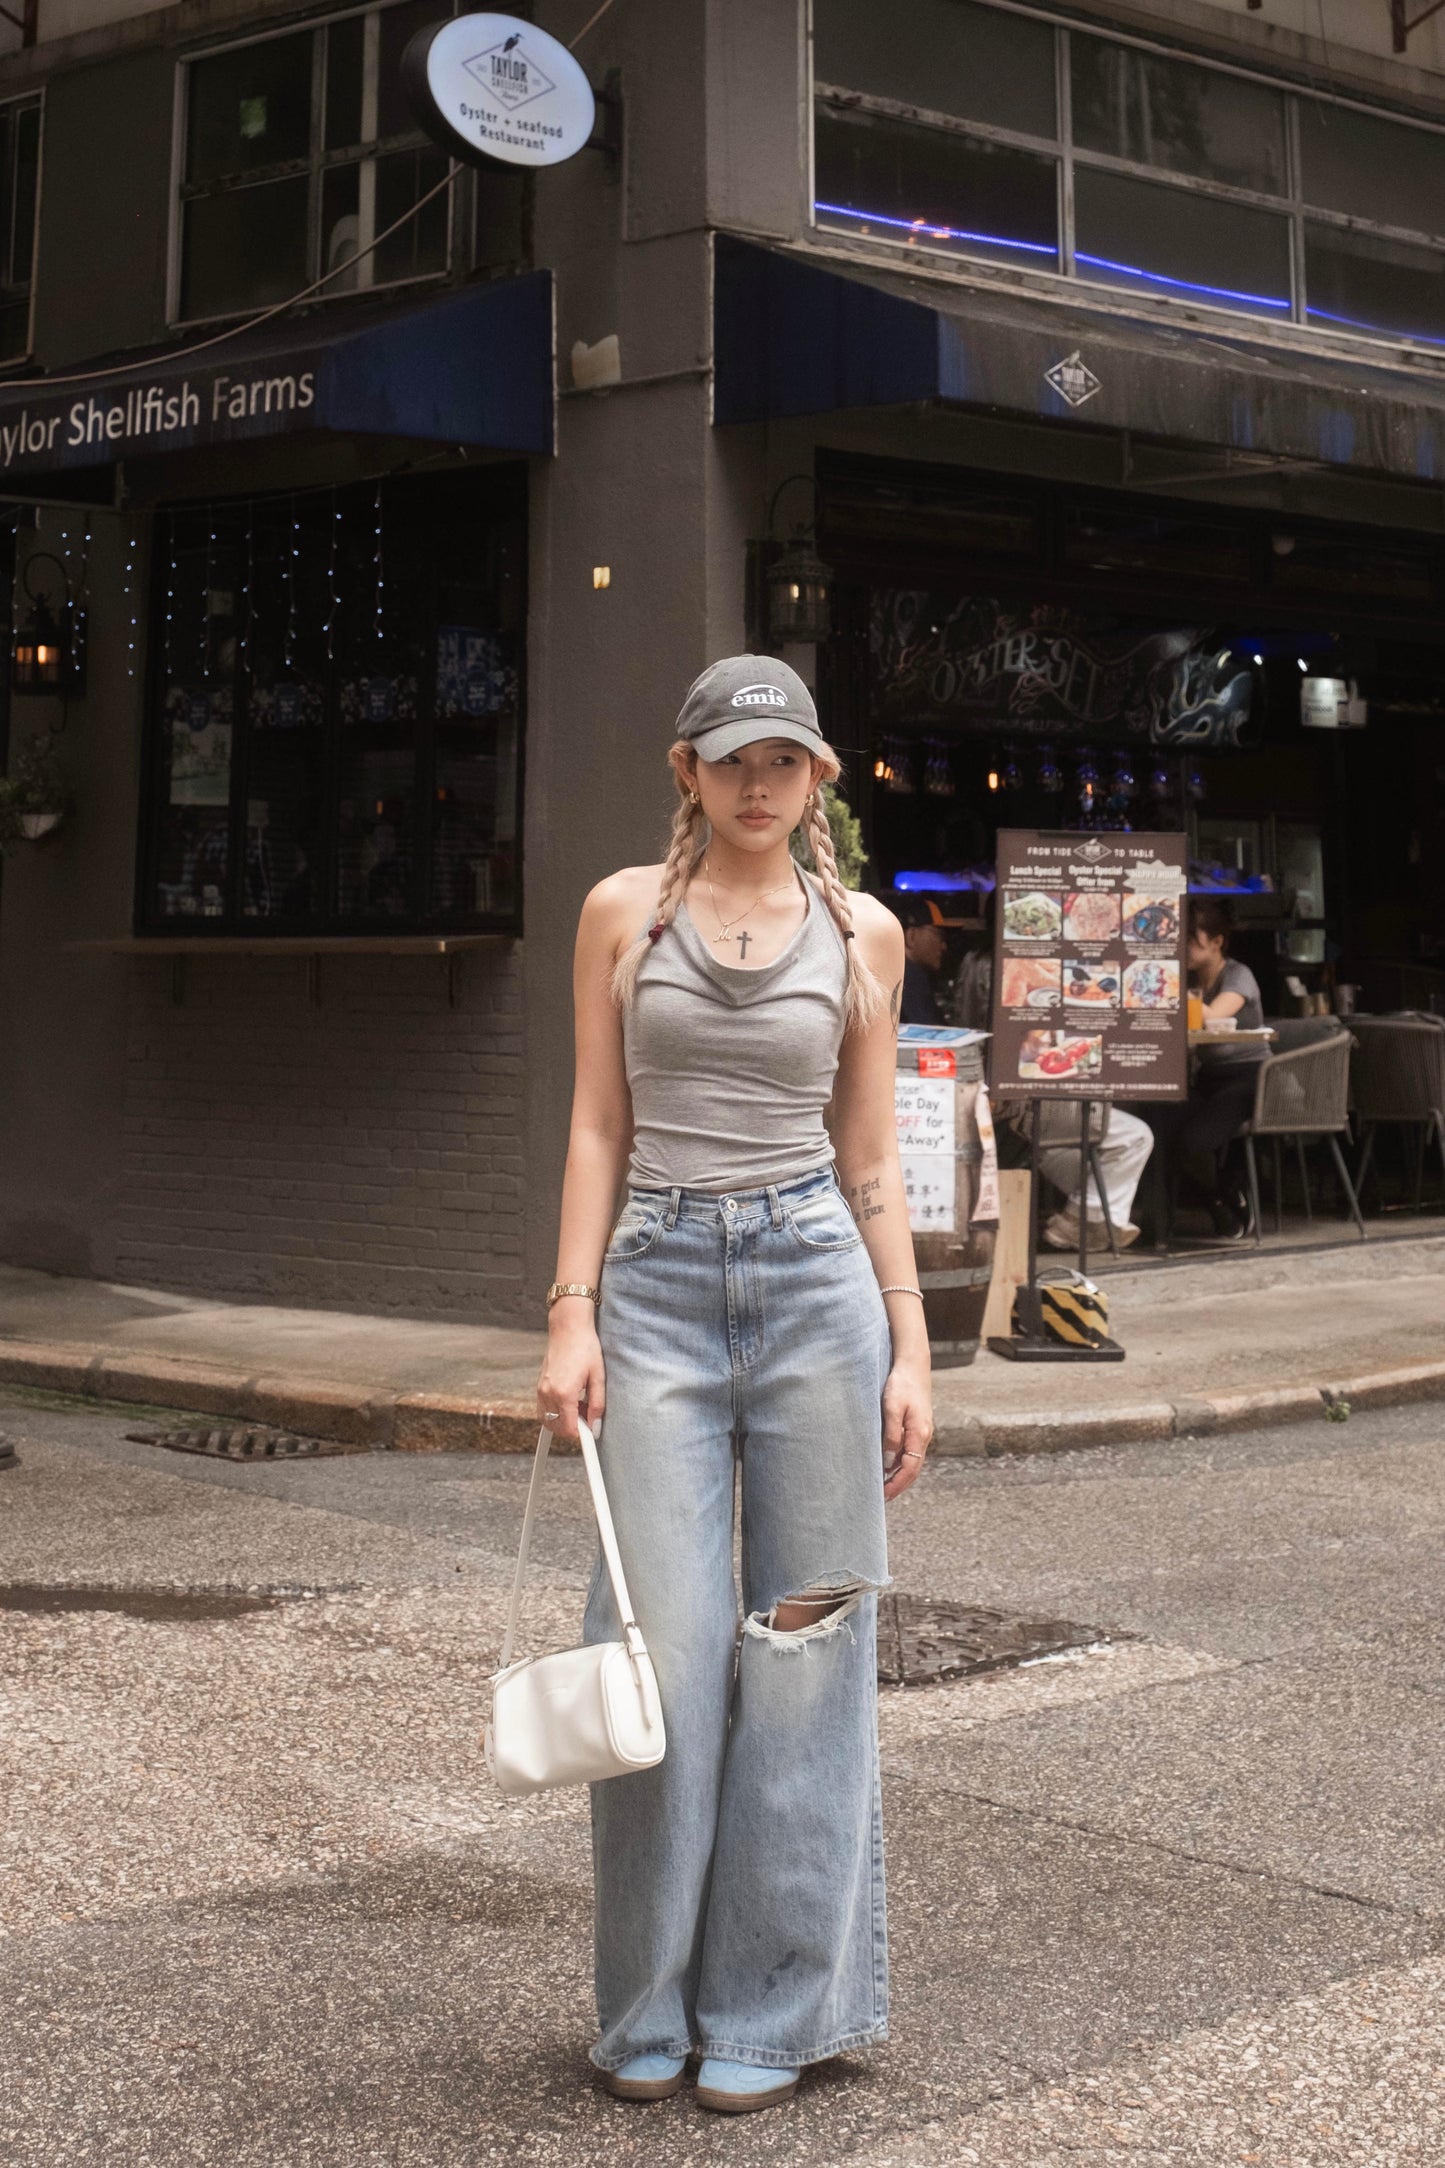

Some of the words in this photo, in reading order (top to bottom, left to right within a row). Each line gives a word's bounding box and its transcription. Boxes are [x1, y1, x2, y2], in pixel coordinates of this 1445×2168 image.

[491, 55, 528, 83] TAYLOR
[460, 103, 498, 123] Oyster
[517, 120, 563, 139] seafood
[480, 124, 546, 151] Restaurant
[0, 409, 62, 468] ylor
[67, 381, 200, 447] Shellfish
[212, 372, 315, 422] Farms
[931, 632, 1038, 703] OYSTER
[731, 689, 787, 708] emis
[1027, 847, 1051, 856] FROM
[1053, 847, 1072, 857] TIDE
[1114, 848, 1126, 857] TO
[1128, 849, 1155, 858] TABLE
[1010, 865, 1033, 876] Lunch
[1034, 865, 1062, 877] Special
[1068, 864, 1094, 876] Oyster
[1094, 865, 1123, 877] Special
[895, 1097, 912, 1109] ole
[917, 1097, 940, 1112] Day
[896, 1115, 921, 1127] OFF
[926, 1116, 943, 1128] for
[897, 1134, 945, 1149] -Away
[861, 1177, 880, 1195] girl
[864, 1204, 886, 1221] gun
